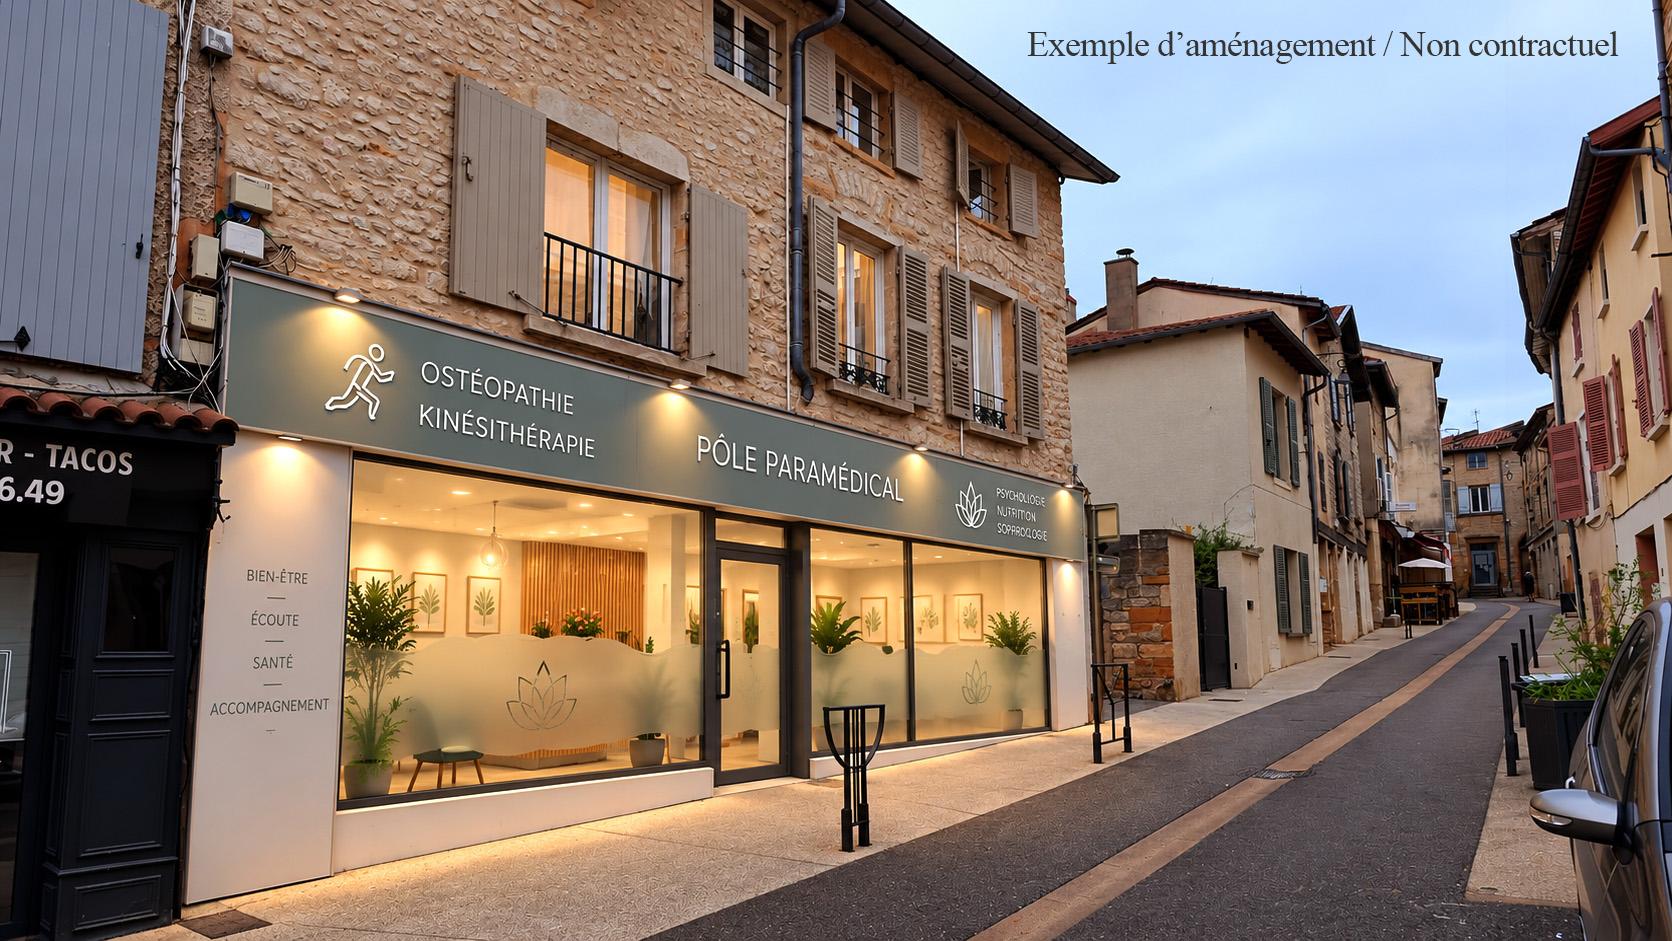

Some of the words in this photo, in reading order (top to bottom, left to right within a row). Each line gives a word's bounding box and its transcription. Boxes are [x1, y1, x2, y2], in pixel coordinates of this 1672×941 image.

[421, 361, 575, 415] OSTÉOPATHIE
[419, 403, 596, 459] KINÉSITHÉRAPIE
[45, 443, 134, 476] TACOS
[697, 433, 757, 473] PÔLE
[766, 450, 904, 503] PARAMÉDICAL
[246, 568, 309, 585] BIEN-ÊTRE
[250, 610, 300, 627] ÉCOUTE
[252, 654, 294, 670] SANTÉ
[209, 698, 330, 717] ACCOMPAGNEMENT
